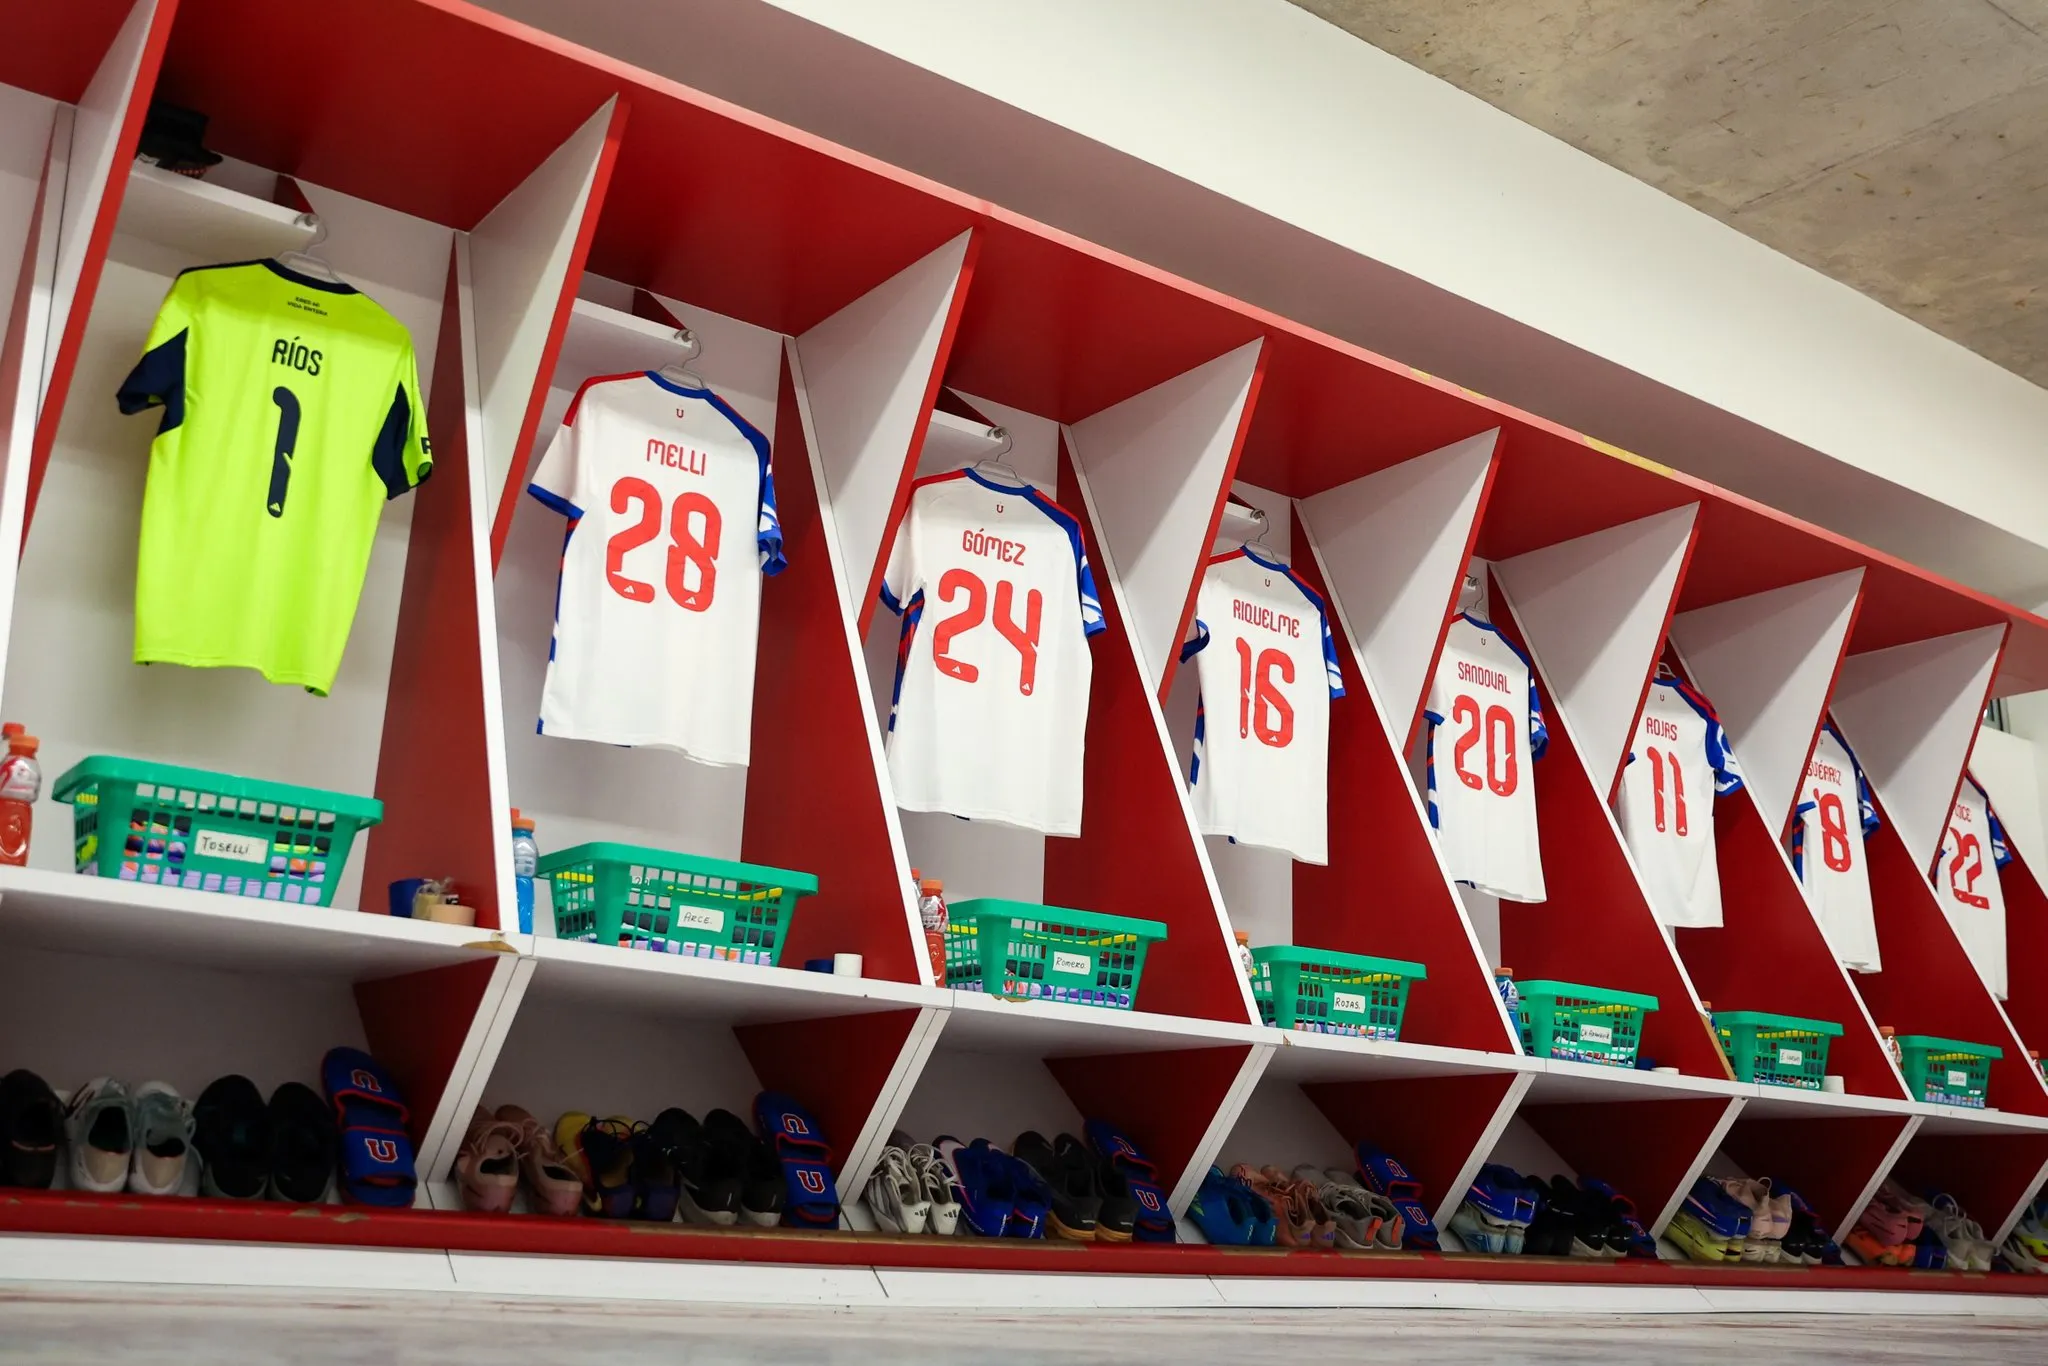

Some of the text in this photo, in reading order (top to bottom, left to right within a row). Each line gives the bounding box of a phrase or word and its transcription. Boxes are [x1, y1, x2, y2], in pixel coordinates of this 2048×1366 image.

[271, 335, 323, 376] RÍOS
[676, 408, 685, 418] U
[267, 386, 301, 518] 1
[646, 438, 706, 476] MELLI
[996, 504, 1004, 514] U
[606, 476, 722, 612] 28
[962, 528, 1026, 566] GÓMEZ
[1264, 578, 1271, 588] U
[933, 568, 1043, 697] 24
[1233, 599, 1300, 639] RIQUELME
[1236, 637, 1295, 748] 16
[1457, 661, 1511, 694] SANDOVAL
[1453, 694, 1518, 797] 20
[1646, 716, 1678, 742] ROJAS
[1647, 746, 1688, 837] 11
[364, 1137, 399, 1163] U
[796, 1169, 826, 1194] U
[1135, 1188, 1161, 1212] U
